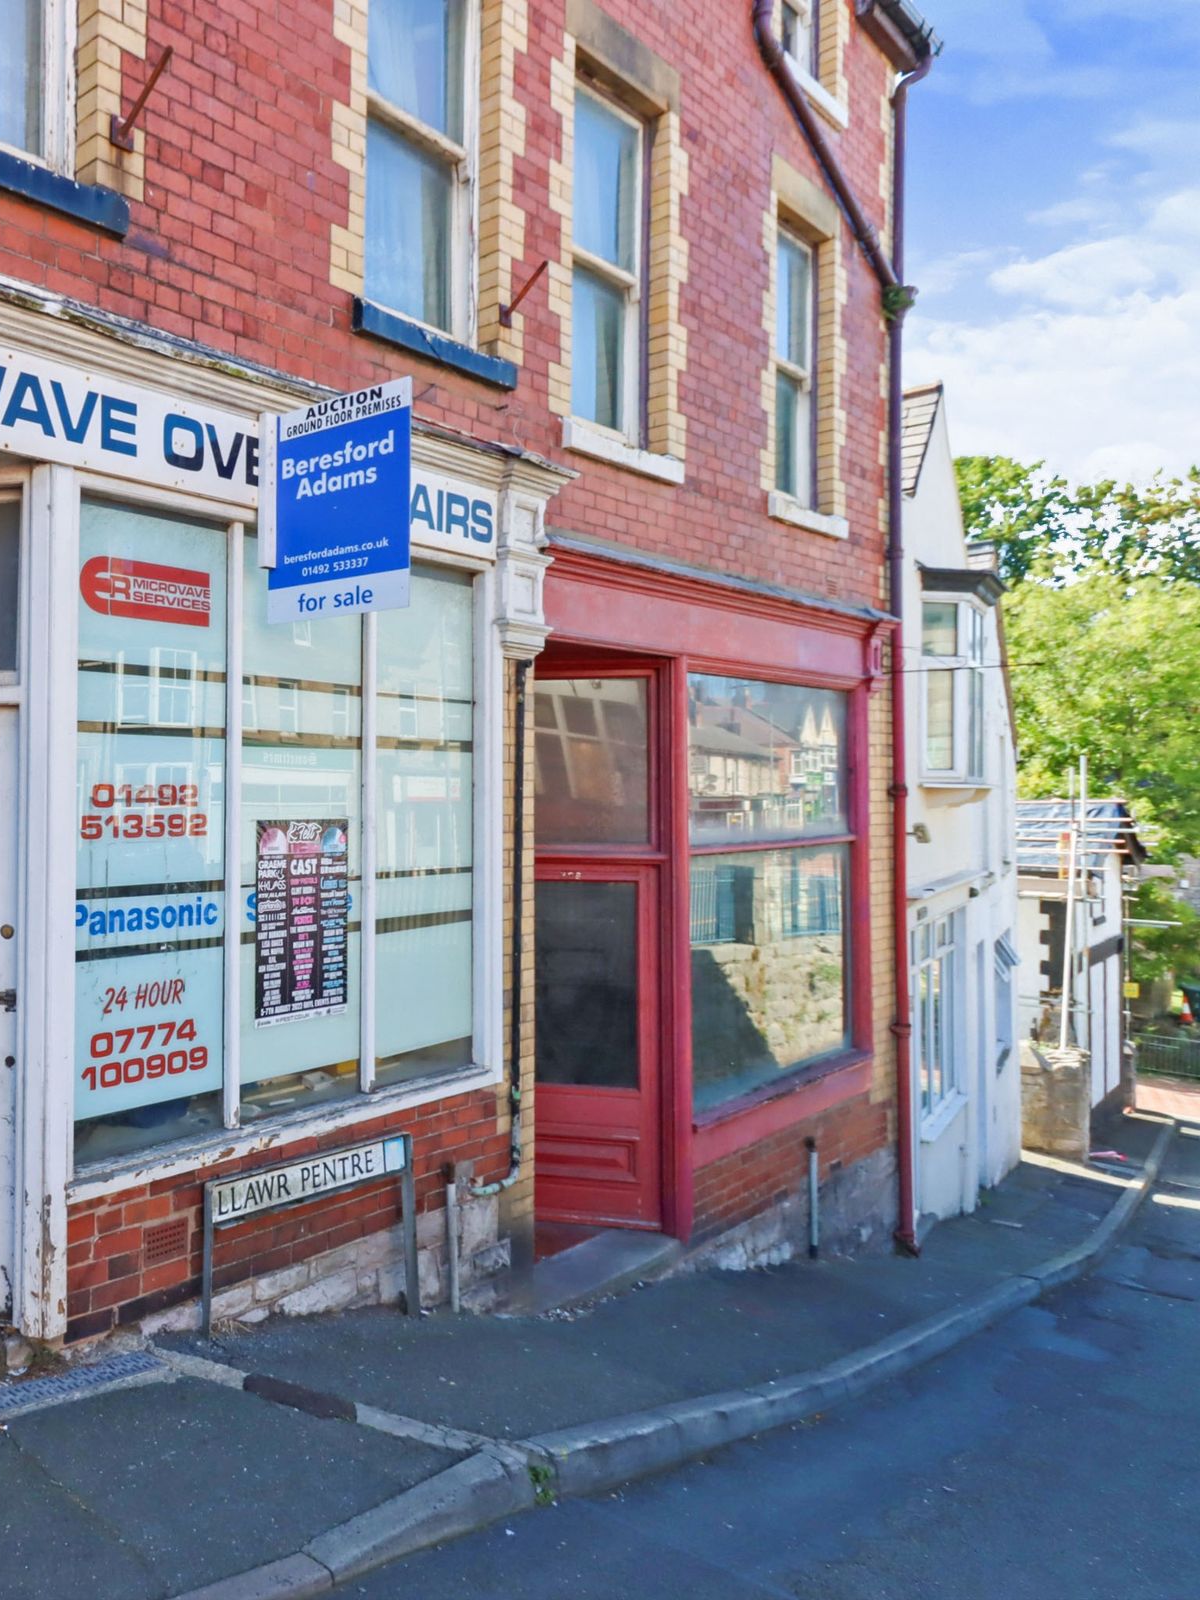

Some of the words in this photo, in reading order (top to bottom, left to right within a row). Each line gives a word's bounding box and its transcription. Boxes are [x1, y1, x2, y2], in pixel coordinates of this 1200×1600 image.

[286, 419, 323, 438] GROUND
[325, 409, 353, 426] FLOOR
[355, 394, 402, 419] PREMISES
[305, 386, 383, 420] AUCTION
[281, 429, 395, 480] Beresford
[296, 466, 378, 500] Adams
[284, 537, 390, 565] beresfordadams.co.uk
[301, 564, 330, 577] 01492
[333, 557, 369, 573] 533337
[133, 591, 212, 612] SERVICES
[297, 593, 326, 613] for
[333, 585, 374, 608] sale
[91, 783, 199, 808] 01492
[80, 813, 208, 840] 513592
[290, 858, 318, 875] CAST
[75, 896, 218, 936] Panasonic
[102, 986, 128, 1015] 24
[134, 978, 186, 1010] HOUR
[90, 1018, 197, 1059] 07774
[81, 1046, 208, 1091] 100909
[217, 1172, 292, 1216] LLAWR
[300, 1149, 375, 1192] PENTRE
